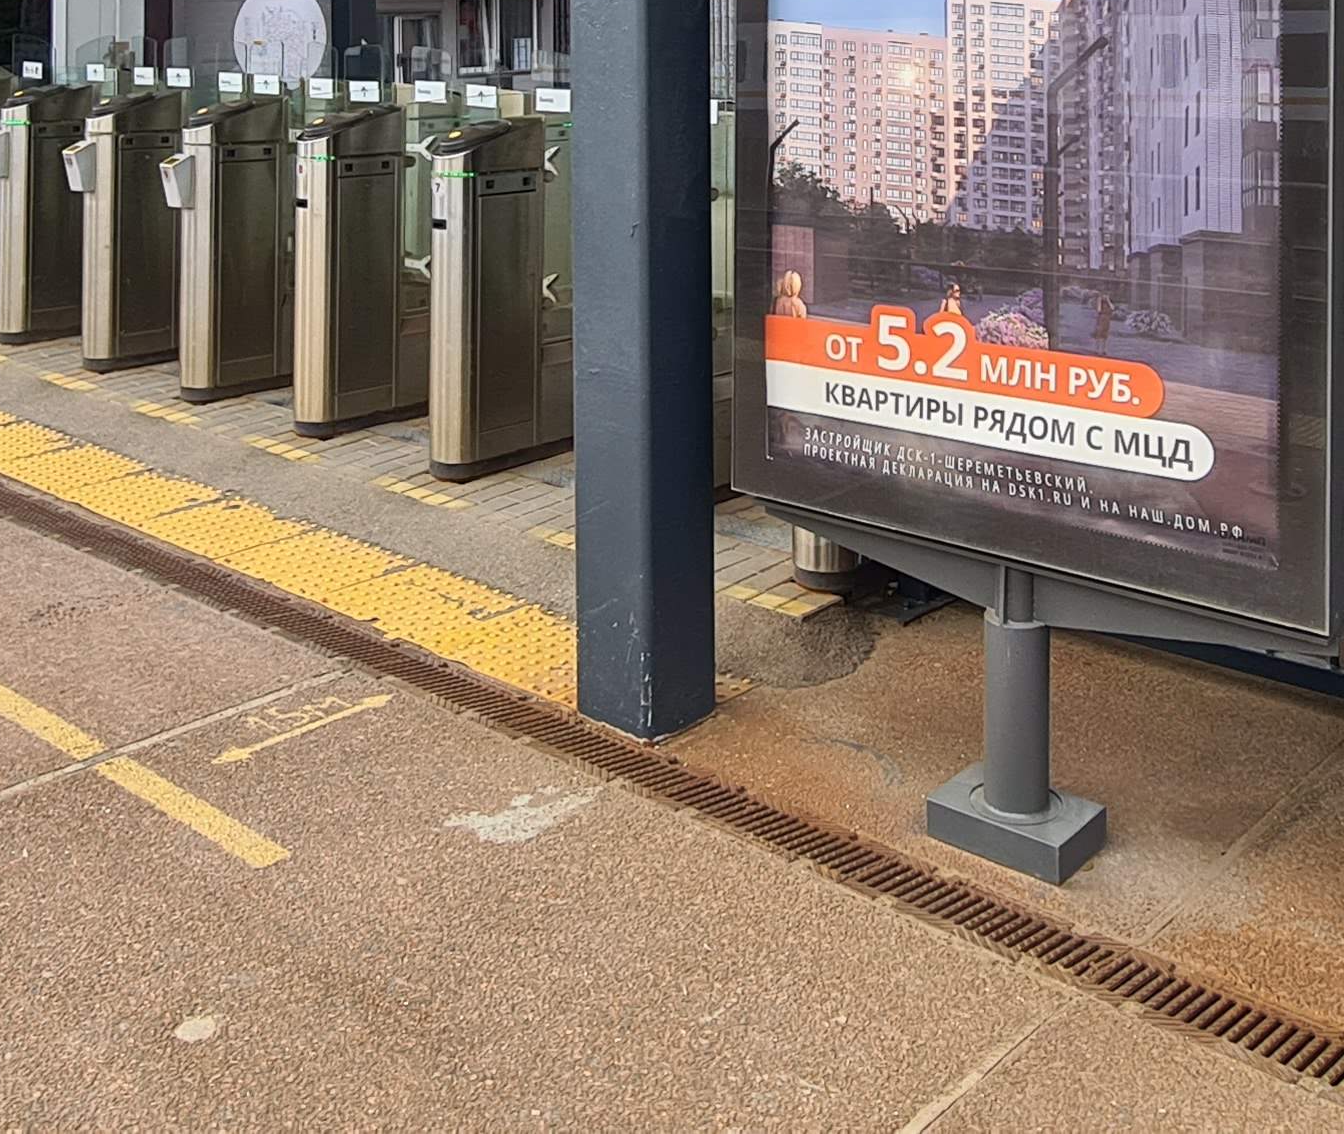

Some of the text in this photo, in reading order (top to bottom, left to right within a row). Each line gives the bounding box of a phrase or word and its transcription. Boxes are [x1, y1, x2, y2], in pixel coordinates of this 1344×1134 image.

[825, 313, 1141, 406] ОТ 5.2 МЛН РУБ.
[805, 426, 1093, 494] ЗАСТРОЙЩИК ДСК-1-ШЕРЕМЕТЬЕВСКИЙ.
[825, 381, 1194, 472] КВАРТИРЫ РЯДОМ С МЦД
[804, 444, 1243, 540] ПРОЕКТНАЯ ДЕКЛАРАЦИЯ НА DSK1.RU И НА НАШ.ДОМ.РФ
